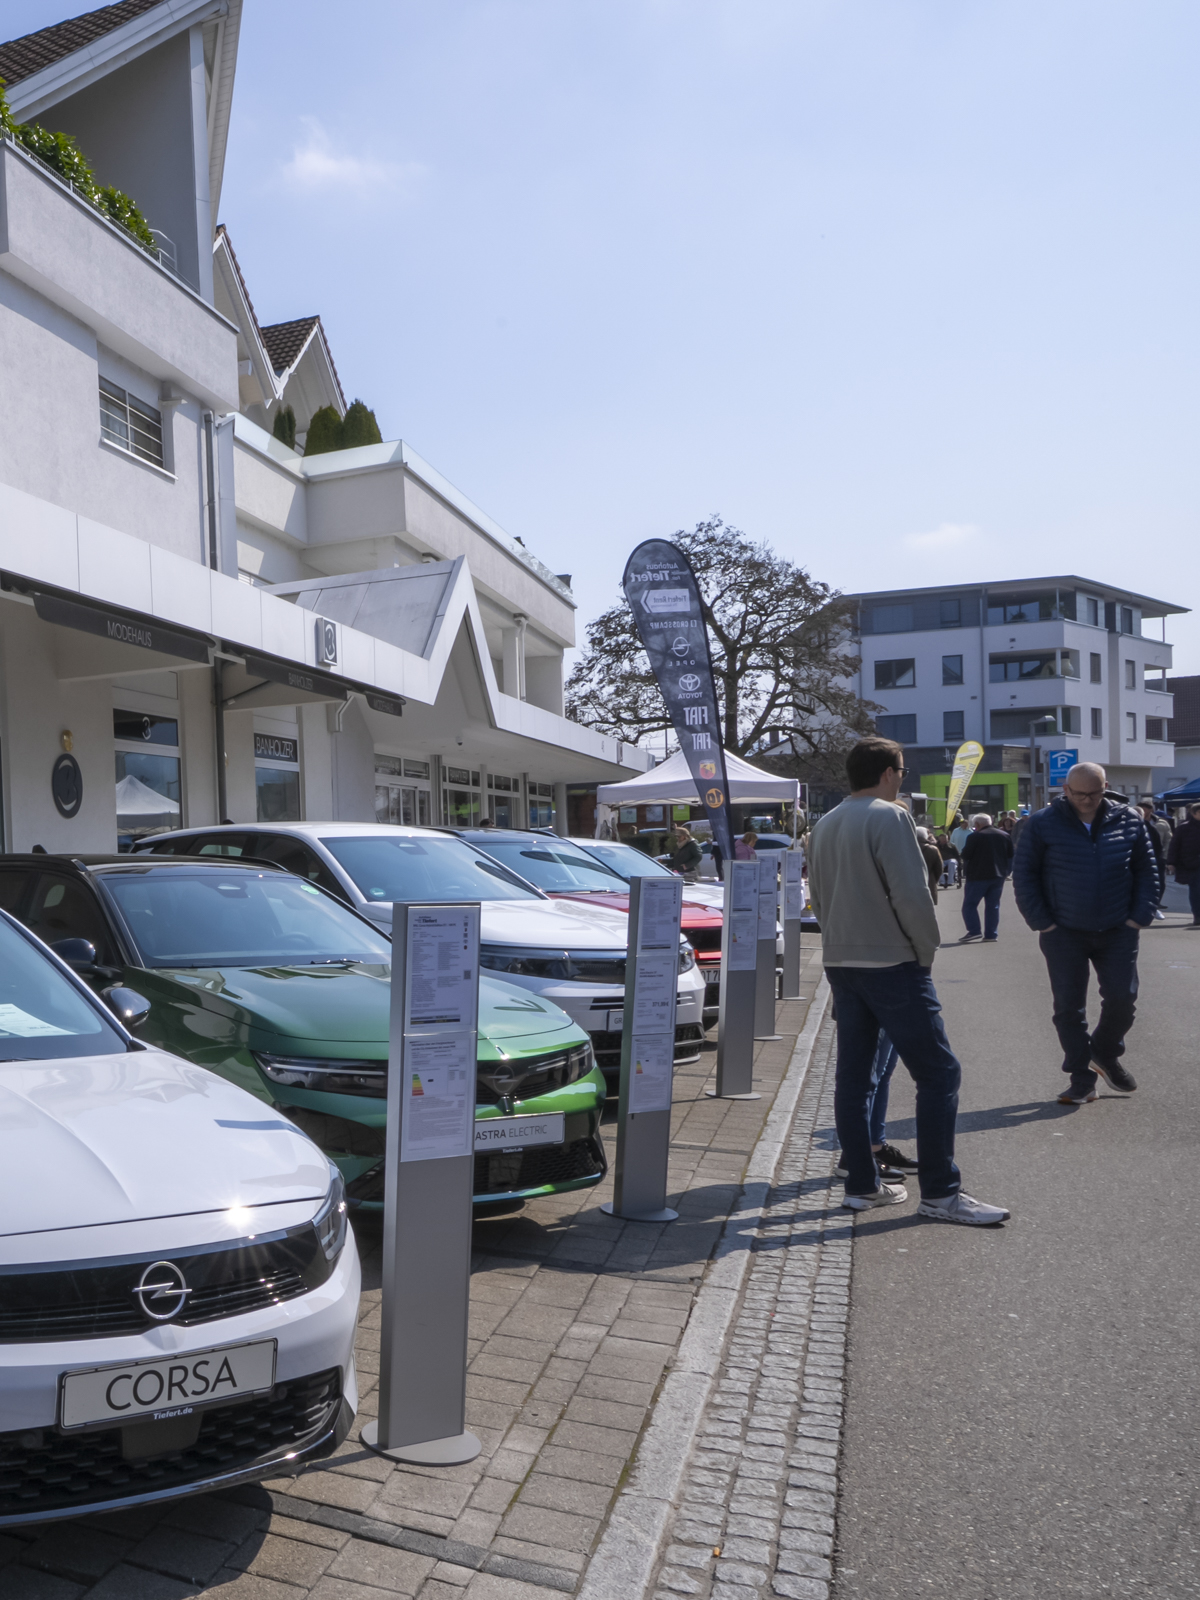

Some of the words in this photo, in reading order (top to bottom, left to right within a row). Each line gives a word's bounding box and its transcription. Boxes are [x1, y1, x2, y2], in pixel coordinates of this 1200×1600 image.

[107, 620, 152, 648] MODEHAUS
[255, 737, 294, 759] BANHOLZER
[1057, 756, 1068, 768] P
[475, 1129, 506, 1141] ASTRA
[508, 1124, 548, 1138] ELECTRIC
[105, 1356, 238, 1411] CORSA
[153, 1406, 193, 1420] Tiefert.de
